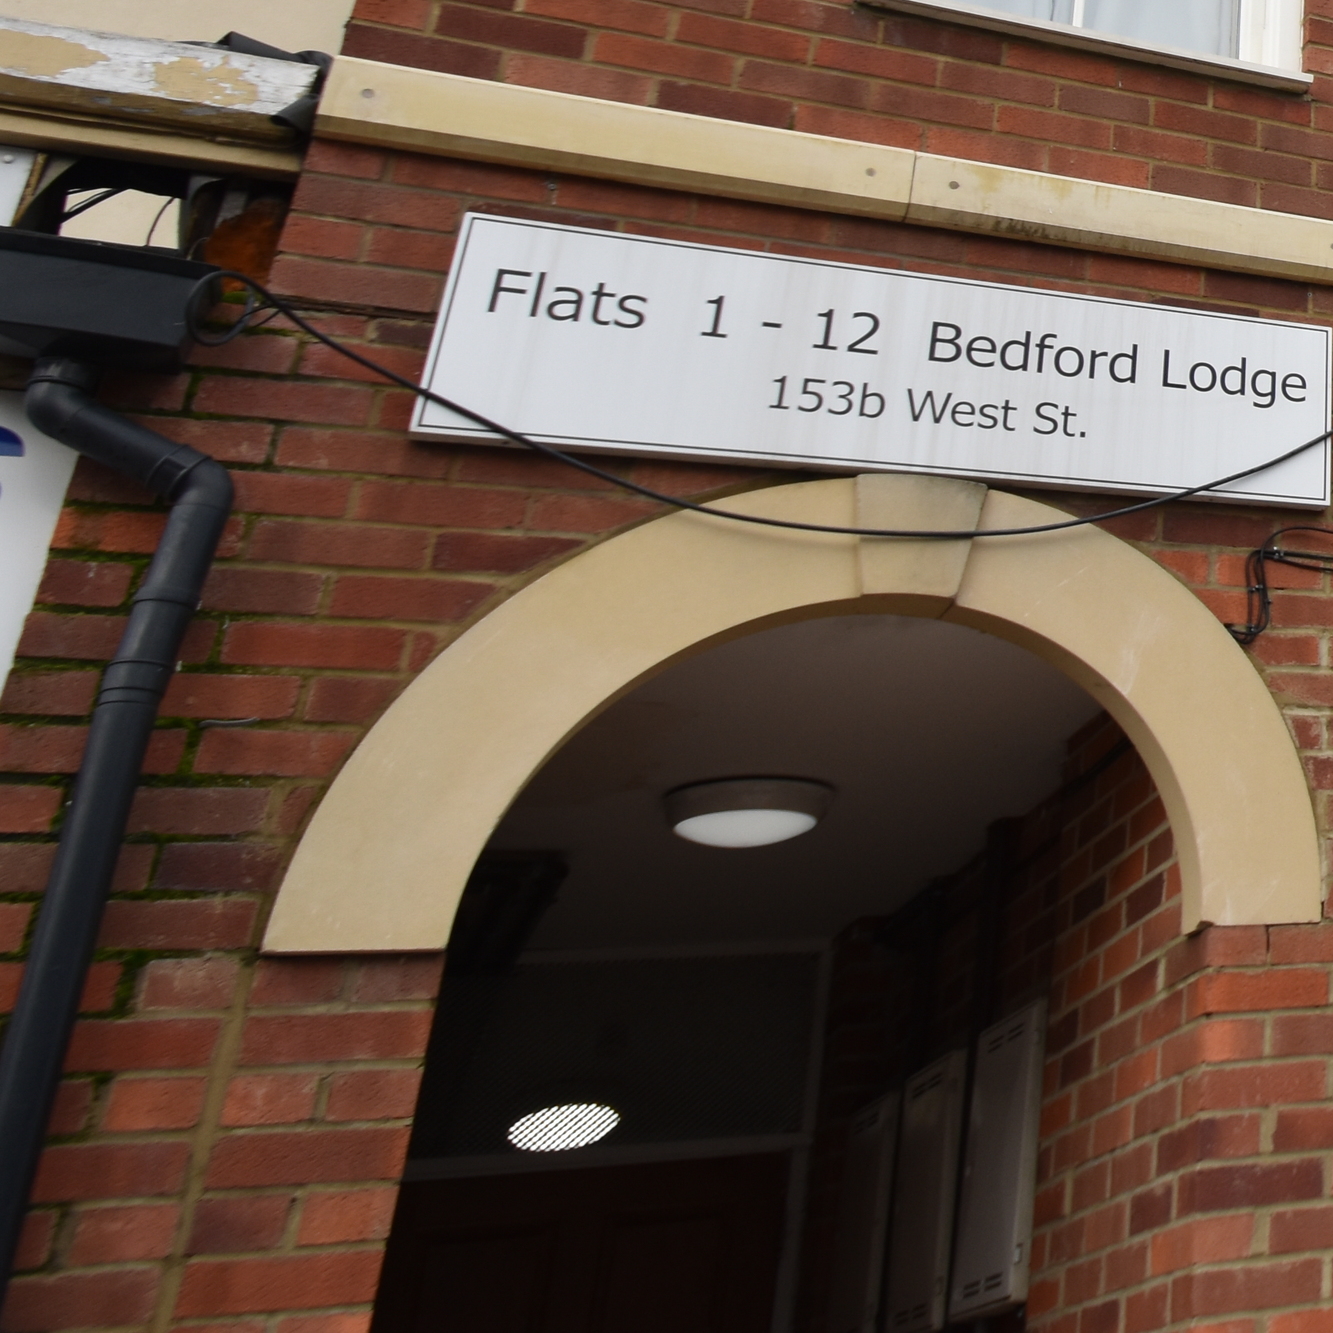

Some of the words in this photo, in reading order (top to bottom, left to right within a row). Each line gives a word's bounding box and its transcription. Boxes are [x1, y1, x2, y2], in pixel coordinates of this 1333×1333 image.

[487, 268, 647, 329] Flats
[700, 295, 727, 339] 1
[812, 308, 881, 356] 12
[926, 321, 1139, 386] Bedford
[1161, 349, 1308, 405] Lodge
[769, 375, 887, 419] 153b
[907, 388, 1018, 433] West
[1033, 401, 1088, 439] St.
